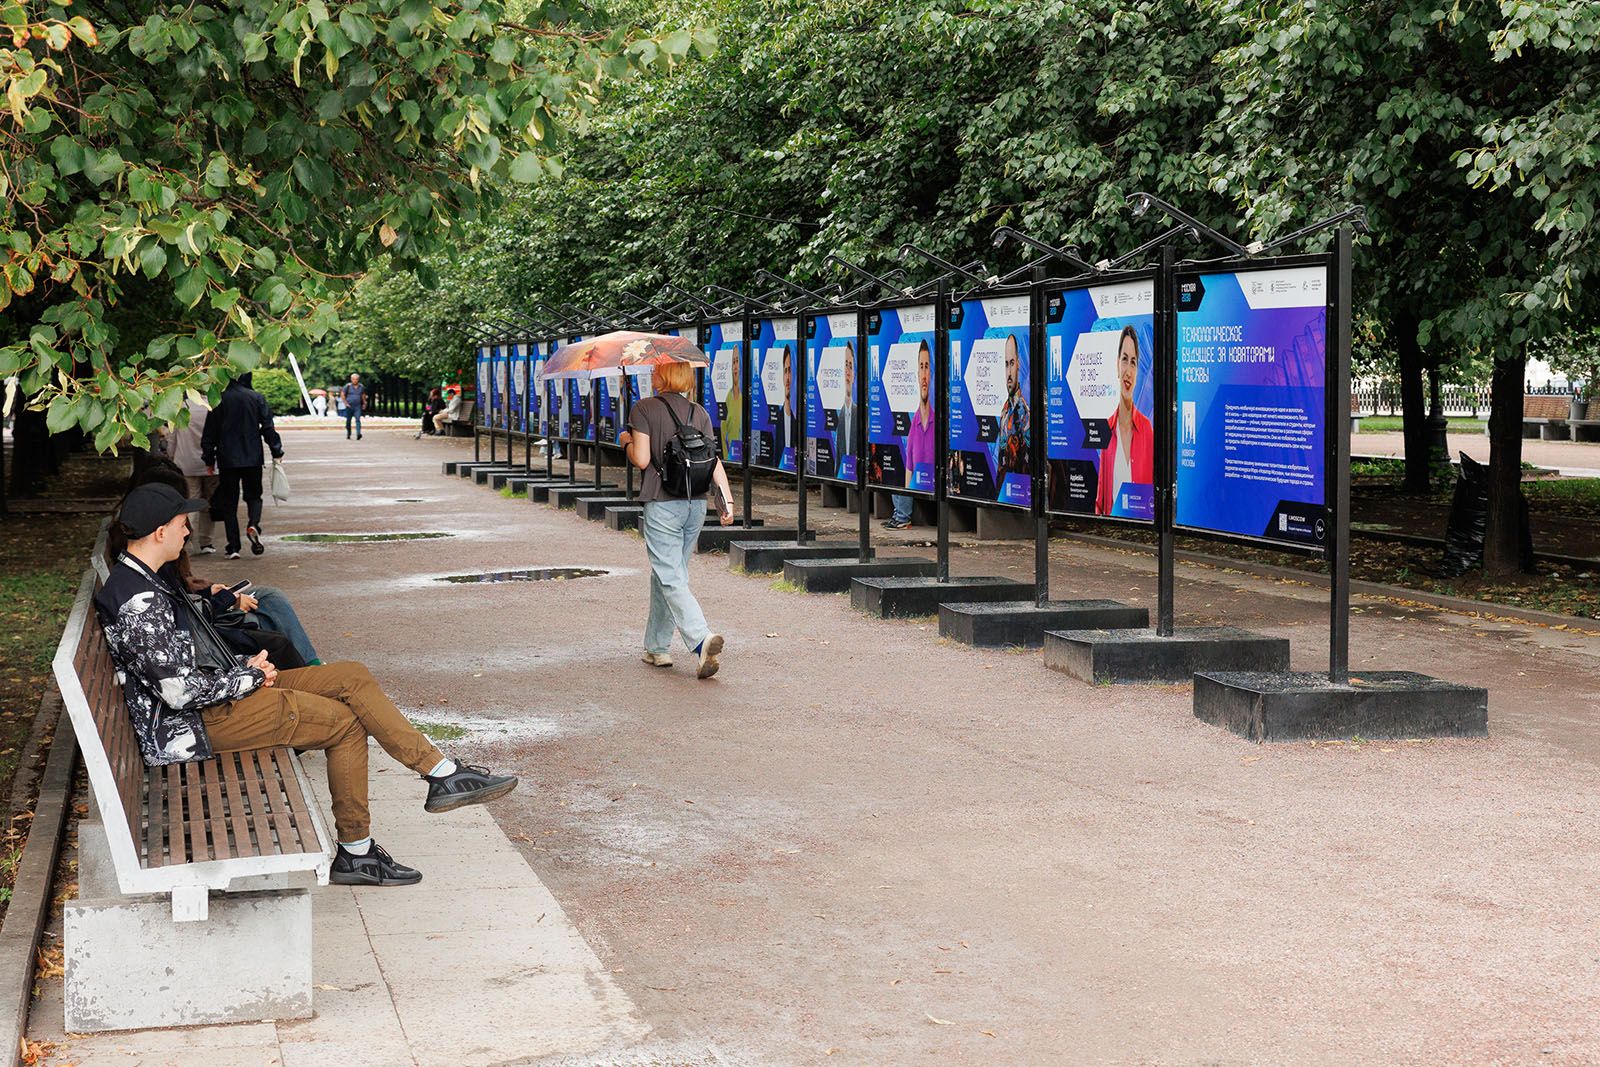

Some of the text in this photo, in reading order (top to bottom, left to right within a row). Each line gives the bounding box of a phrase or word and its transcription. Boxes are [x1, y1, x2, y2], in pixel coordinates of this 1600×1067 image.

[1182, 326, 1243, 342] ТЕХНОЛОГИЧЕСКОЕ
[1182, 347, 1274, 364] БУДУЩЕЕ ЗА НОВАТОРАМИ
[1182, 368, 1209, 383] МОСКВЫ
